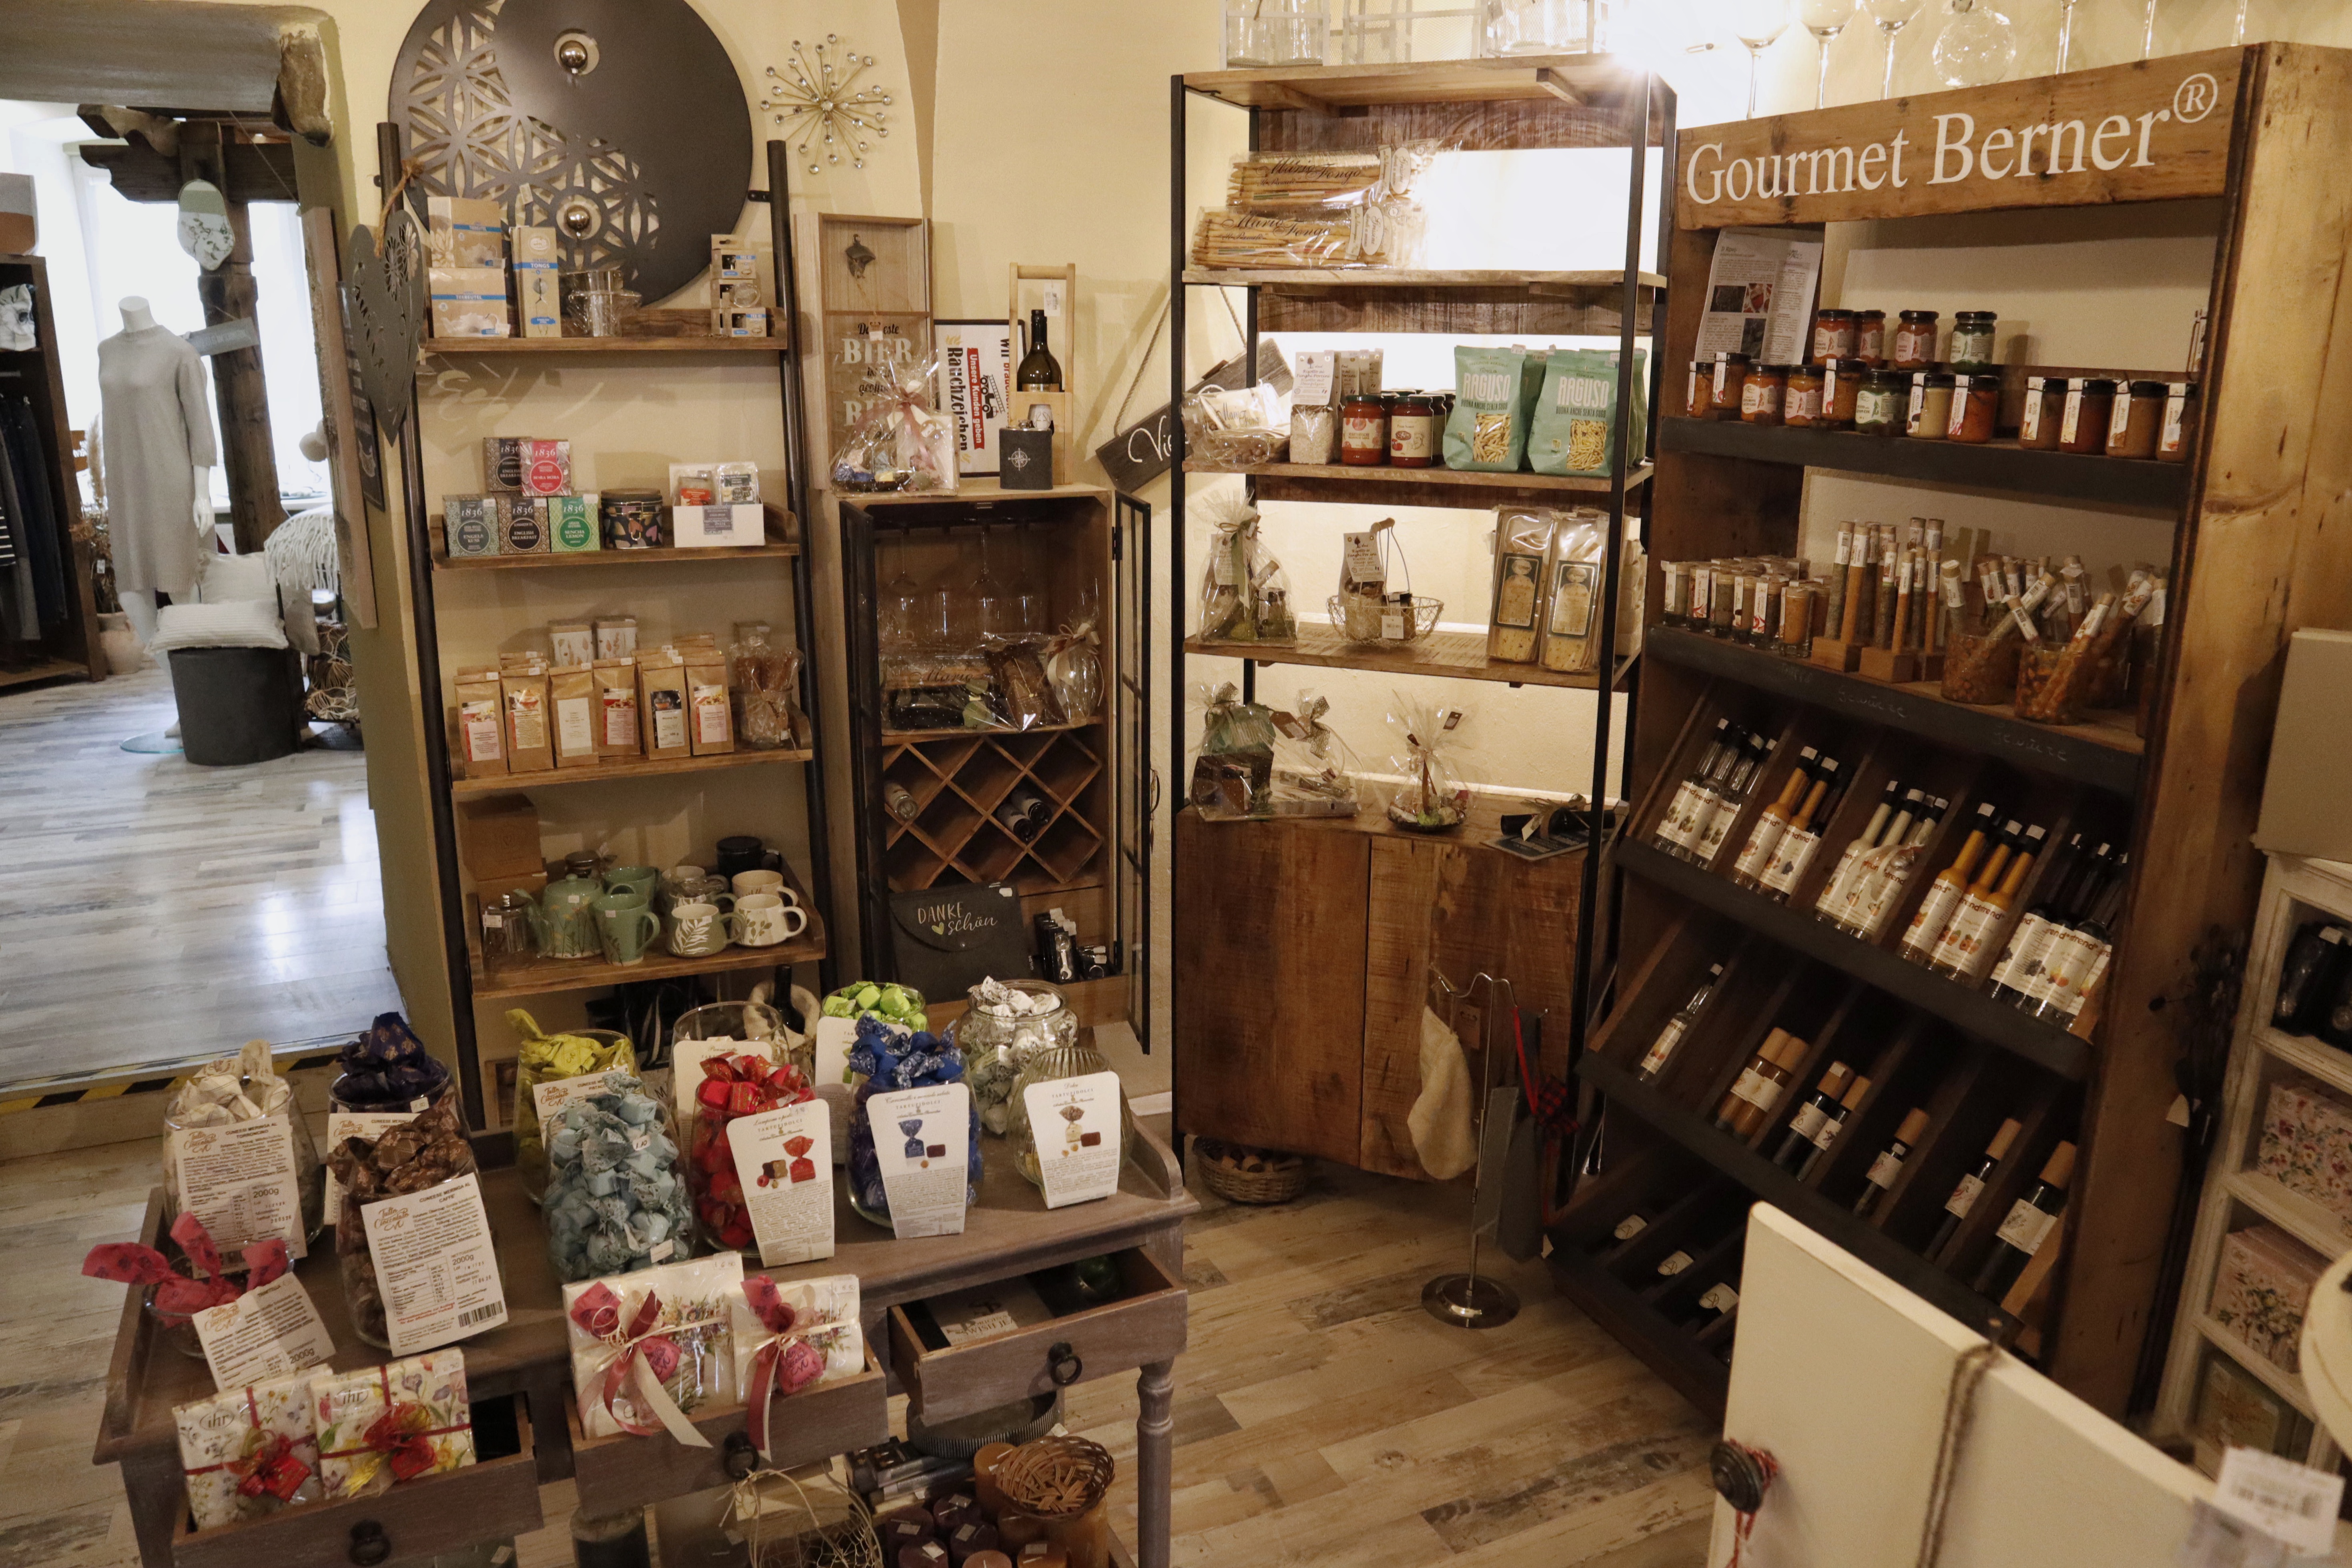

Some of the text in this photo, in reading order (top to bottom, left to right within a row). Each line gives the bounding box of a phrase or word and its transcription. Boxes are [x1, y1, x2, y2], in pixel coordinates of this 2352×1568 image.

[1686, 128, 1909, 205] Gourmet
[841, 337, 912, 364] BIER
[1462, 373, 1511, 402] RAGUSO
[1557, 376, 1609, 409] RAGUSO
[947, 347, 969, 451] Rauchzeichen
[969, 354, 983, 444] Unsere Kunden geben
[1461, 399, 1474, 408] BUONA
[1474, 401, 1486, 410] ANCHE
[1486, 403, 1498, 411] SENZA
[1556, 406, 1606, 418] BUONA ANCHE SENZA SUGO
[535, 448, 556, 458] 1836
[461, 507, 483, 518] 1836
[513, 506, 533, 516] 1836
[563, 504, 583, 513] 1836
[918, 902, 963, 924] DANKE
[253, 1187, 279, 1199] 2000g
[443, 1185, 465, 1195] MERINGA
[452, 1254, 474, 1265] 2000g
[289, 1347, 315, 1365] 2000g
[343, 1391, 362, 1405] ihr
[208, 1412, 229, 1429] ihr
